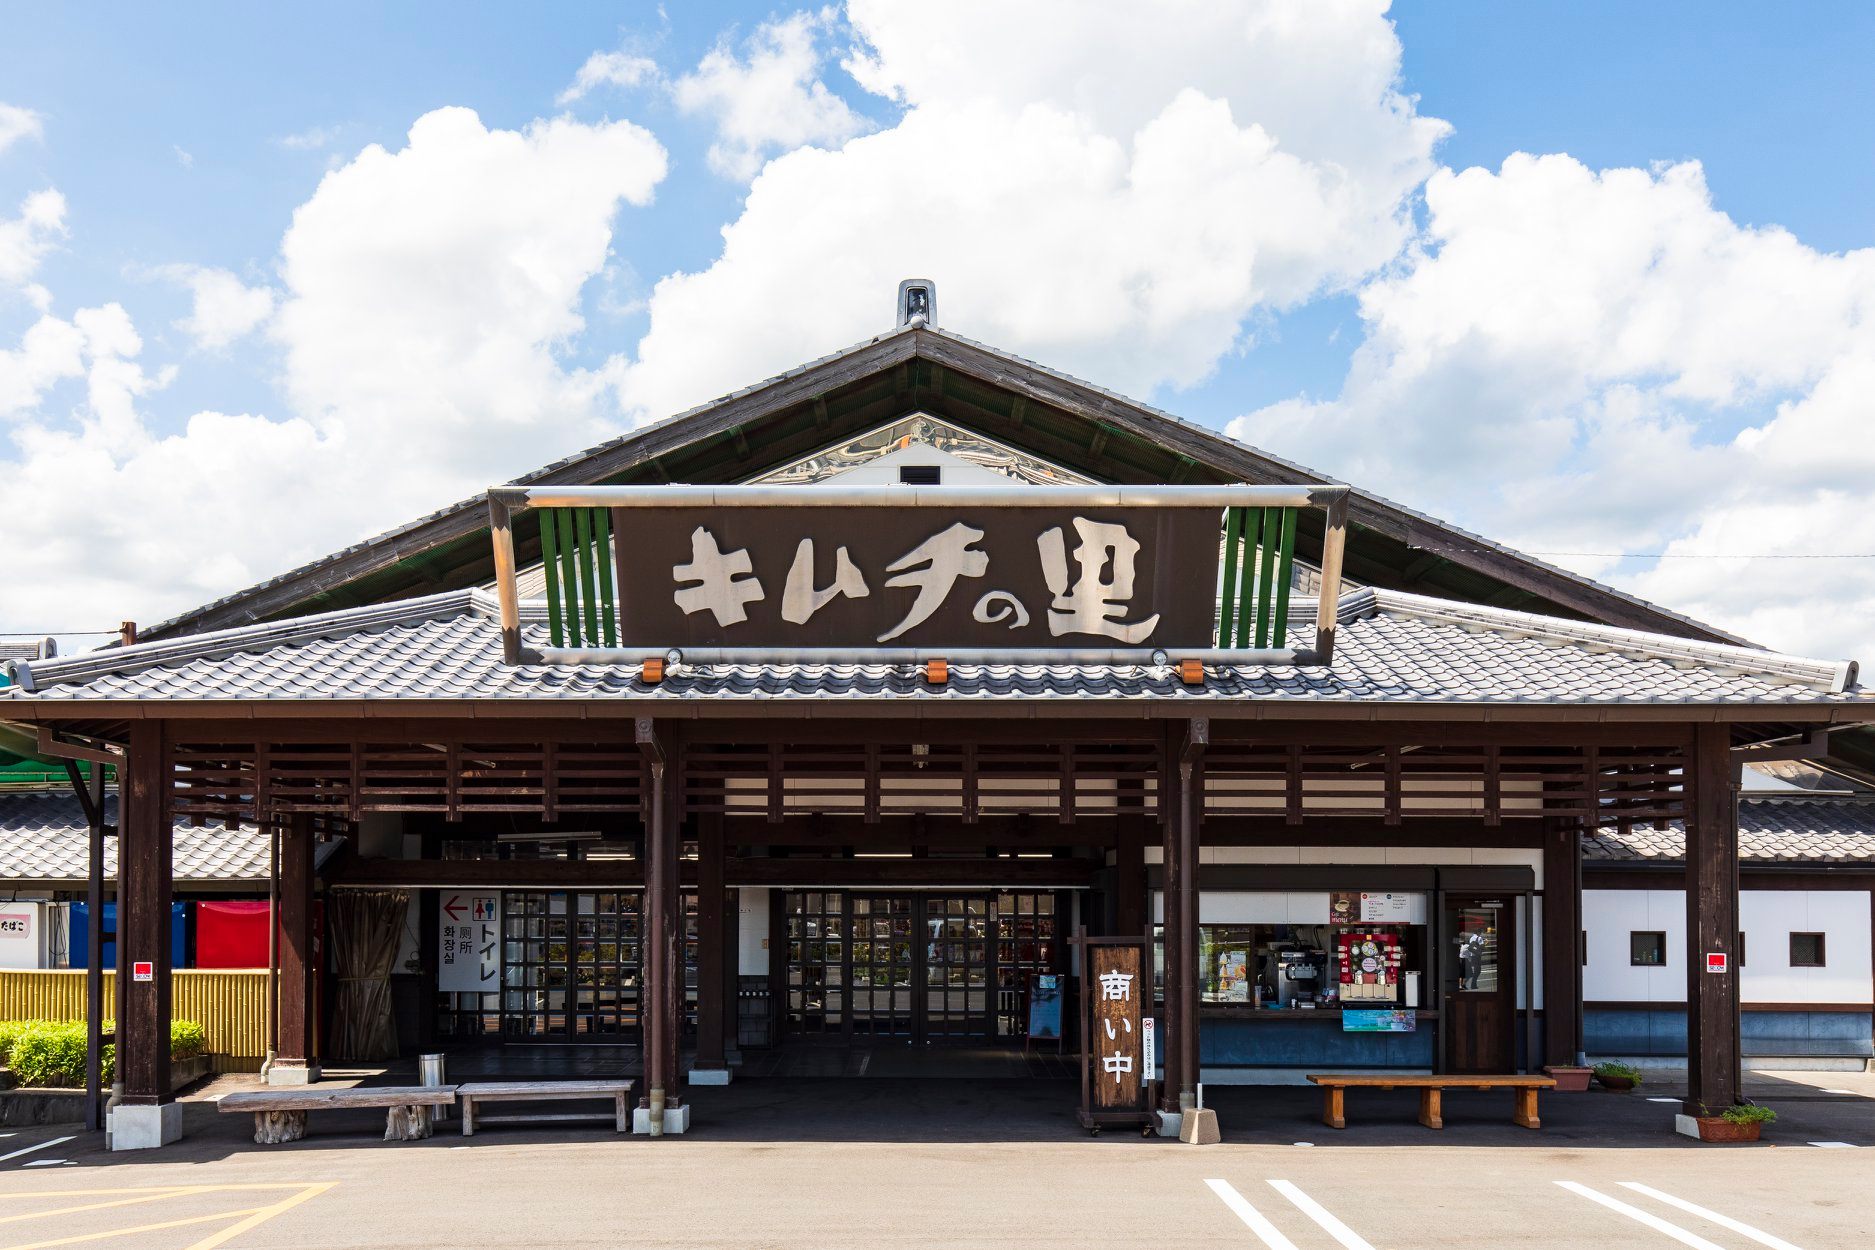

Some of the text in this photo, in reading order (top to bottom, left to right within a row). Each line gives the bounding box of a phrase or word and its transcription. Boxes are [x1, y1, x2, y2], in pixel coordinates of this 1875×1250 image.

[673, 516, 1160, 644] キムチの里
[1, 920, 24, 932] たばこ
[443, 925, 456, 965] 화장실
[479, 923, 497, 981] トイレ
[1099, 969, 1134, 1084] 商い中
